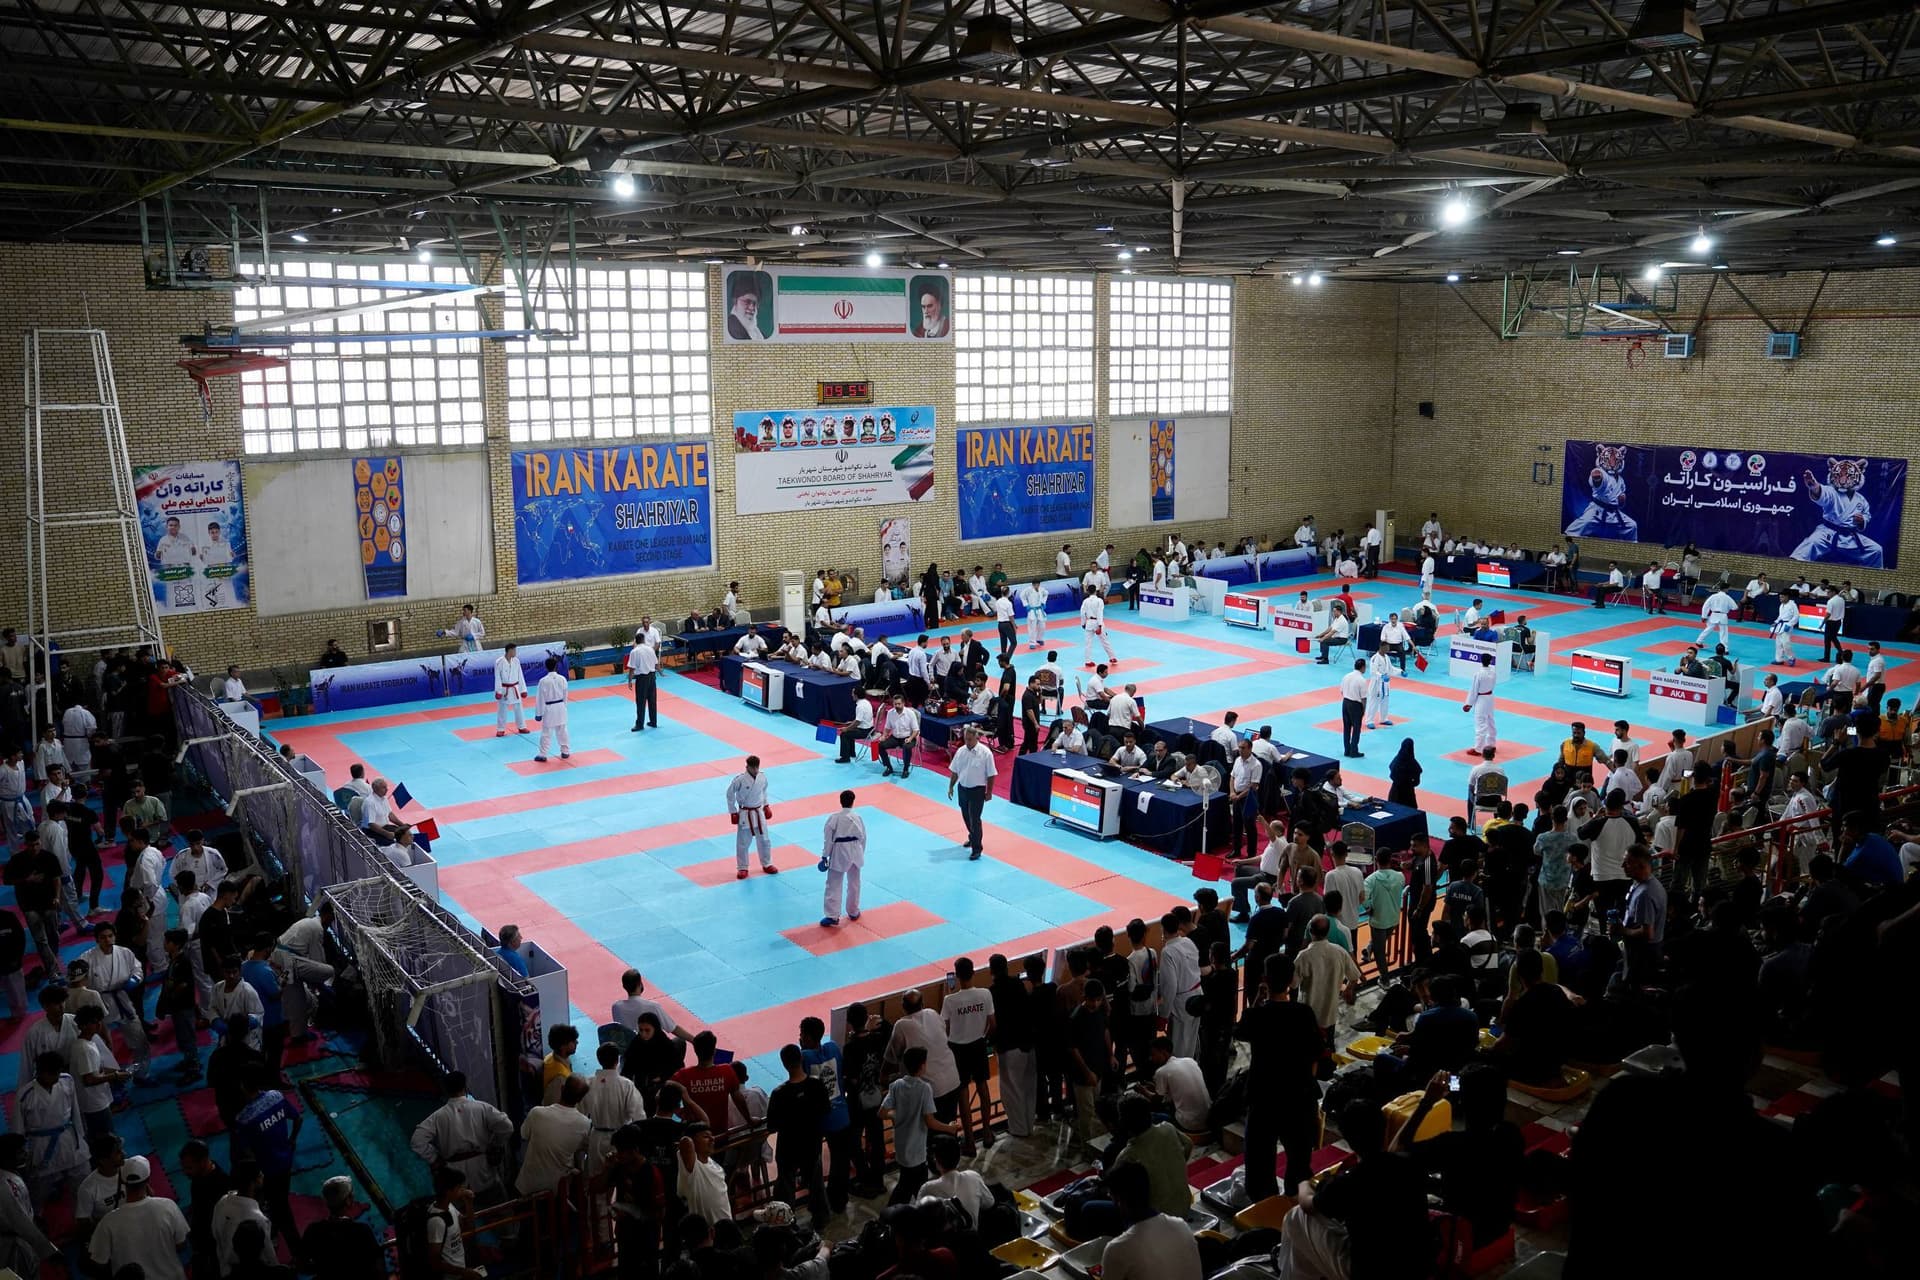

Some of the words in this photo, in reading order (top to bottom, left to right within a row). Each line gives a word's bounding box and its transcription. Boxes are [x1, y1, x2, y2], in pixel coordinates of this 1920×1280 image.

[966, 430, 1014, 468] IRAN
[1020, 426, 1092, 464] KARATE
[525, 450, 595, 497] IRAN
[604, 444, 707, 492] KARATE
[799, 467, 816, 475] شهریار
[818, 464, 843, 473] شهرستان
[778, 476, 821, 484] TAEKWONDO
[823, 474, 845, 482] BOARD
[858, 471, 892, 480] SHAHRYAR
[1027, 472, 1085, 496] SHAHRIYAR
[1663, 471, 1712, 489] کاراته
[156, 483, 181, 498] وان
[184, 480, 224, 495] کاراته
[1713, 476, 1797, 495] فدراسیون
[161, 500, 177, 510] ملی
[179, 499, 193, 508] تیم
[195, 496, 225, 507] انتخابی
[1662, 493, 1693, 506] ایران
[1694, 497, 1741, 509] اسلامی
[616, 499, 699, 529] SHAHRIYAR
[1742, 502, 1795, 516] جمهوری
[634, 539, 649, 549] ONE
[1288, 620, 1299, 628] AKA
[381, 677, 418, 688] FEDERATION
[1680, 680, 1706, 689] FEDERATION
[1670, 690, 1686, 699] AKA
[957, 1002, 984, 1016] KARATE
[690, 1085, 725, 1094] COACH
[259, 1108, 285, 1132] IRAN
